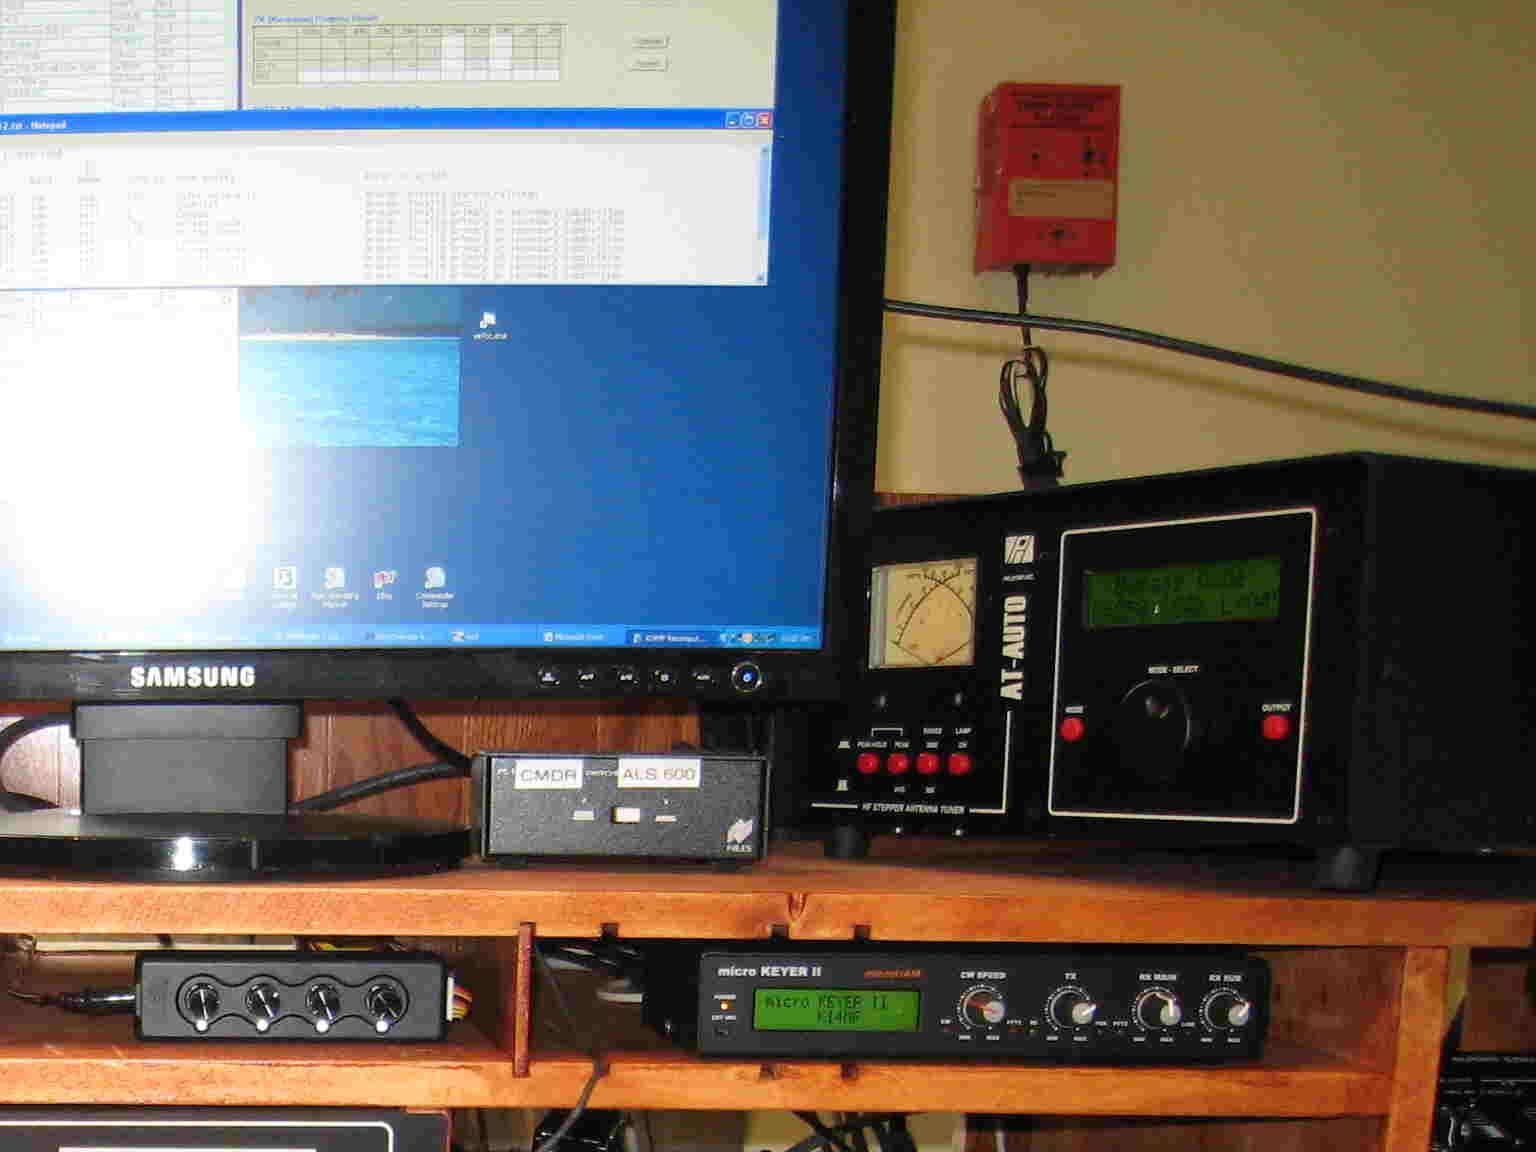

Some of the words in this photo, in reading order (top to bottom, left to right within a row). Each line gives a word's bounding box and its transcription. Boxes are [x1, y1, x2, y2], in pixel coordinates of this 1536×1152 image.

[1000, 594, 1026, 700] AT-AUTO
[130, 665, 257, 689] SAMSUNG
[1261, 703, 1293, 712] OUTPUT
[520, 768, 577, 782] CMDR
[623, 768, 658, 782] ALS
[663, 767, 696, 781] 600
[718, 965, 756, 977] micro
[761, 965, 809, 977] KEYER
[811, 965, 822, 977] II
